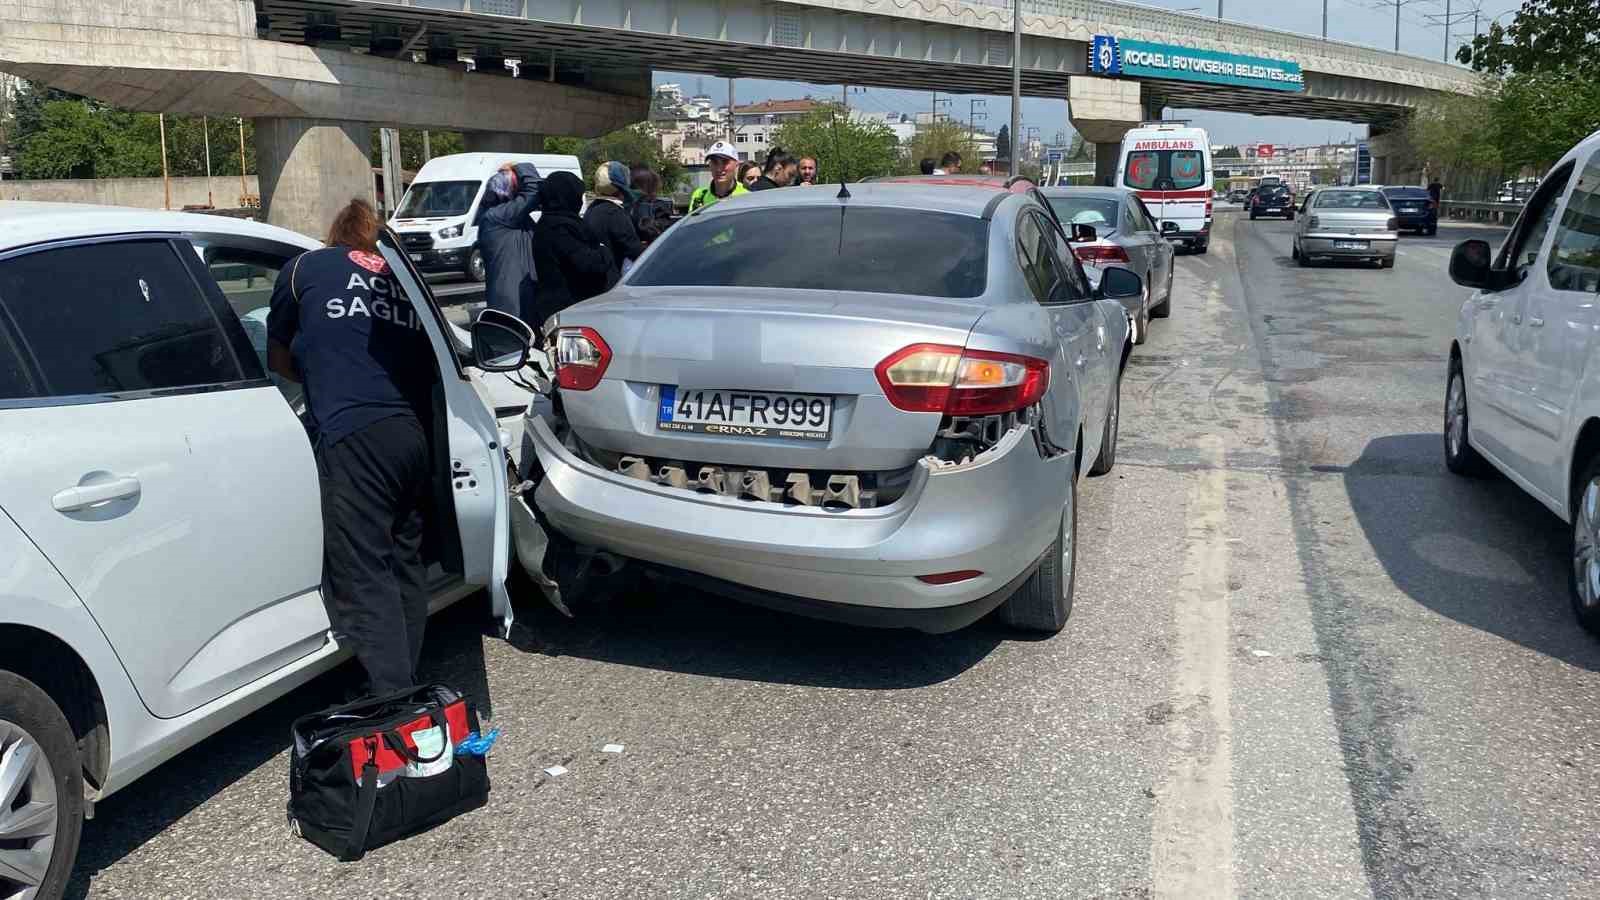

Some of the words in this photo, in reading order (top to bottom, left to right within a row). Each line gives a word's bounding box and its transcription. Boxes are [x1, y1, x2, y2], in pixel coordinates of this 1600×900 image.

[1124, 50, 1170, 67] KOCAELİ
[1135, 141, 1194, 150] AMBULANS
[326, 295, 421, 331] SAĞLI
[662, 405, 673, 415] TR
